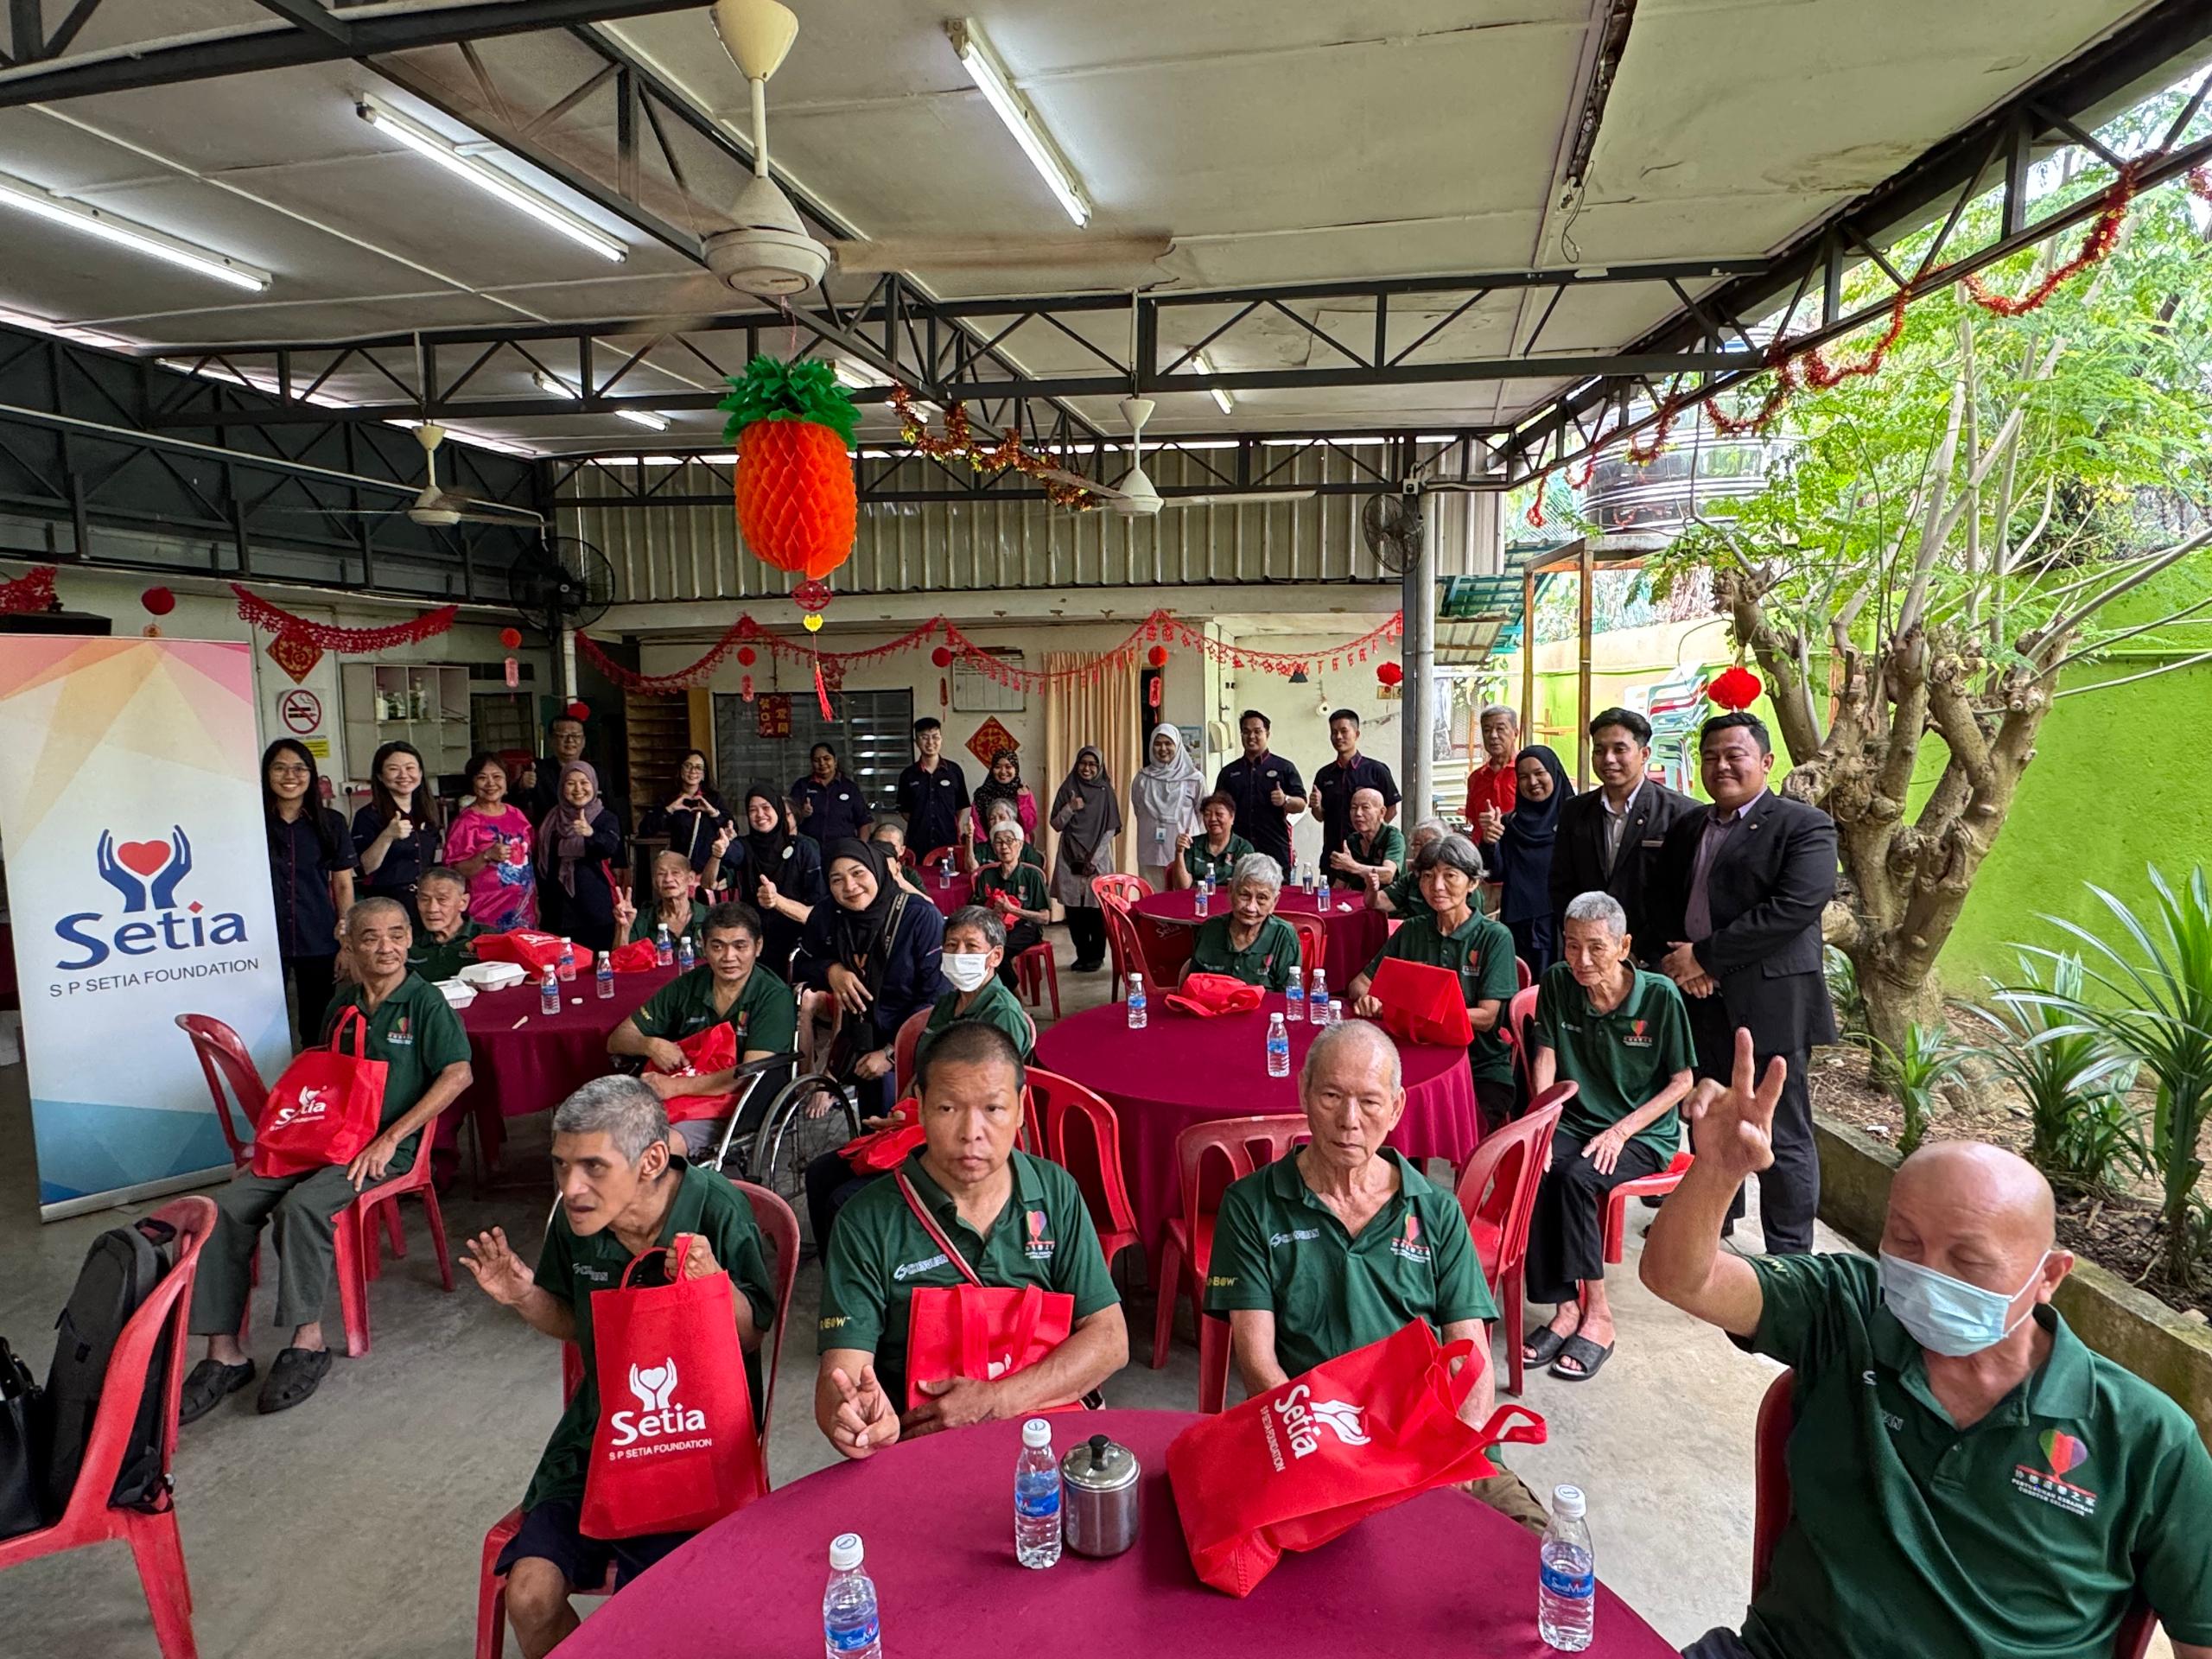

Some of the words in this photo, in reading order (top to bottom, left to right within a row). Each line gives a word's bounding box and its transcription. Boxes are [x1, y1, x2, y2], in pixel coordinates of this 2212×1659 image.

[54, 900, 249, 970] Setia
[49, 984, 62, 997] S
[69, 982, 80, 995] P
[86, 973, 140, 992] SETIA
[144, 957, 259, 983] FOUNDATION
[275, 1099, 326, 1125] Stia
[611, 1402, 706, 1446] Setia
[1274, 1384, 1321, 1459] Setia
[609, 1452, 615, 1461] S
[617, 1451, 624, 1459] P
[626, 1447, 652, 1459] SETIA
[653, 1438, 712, 1453] FOUNDATION
[1266, 1427, 1286, 1472] FOUNDATION
